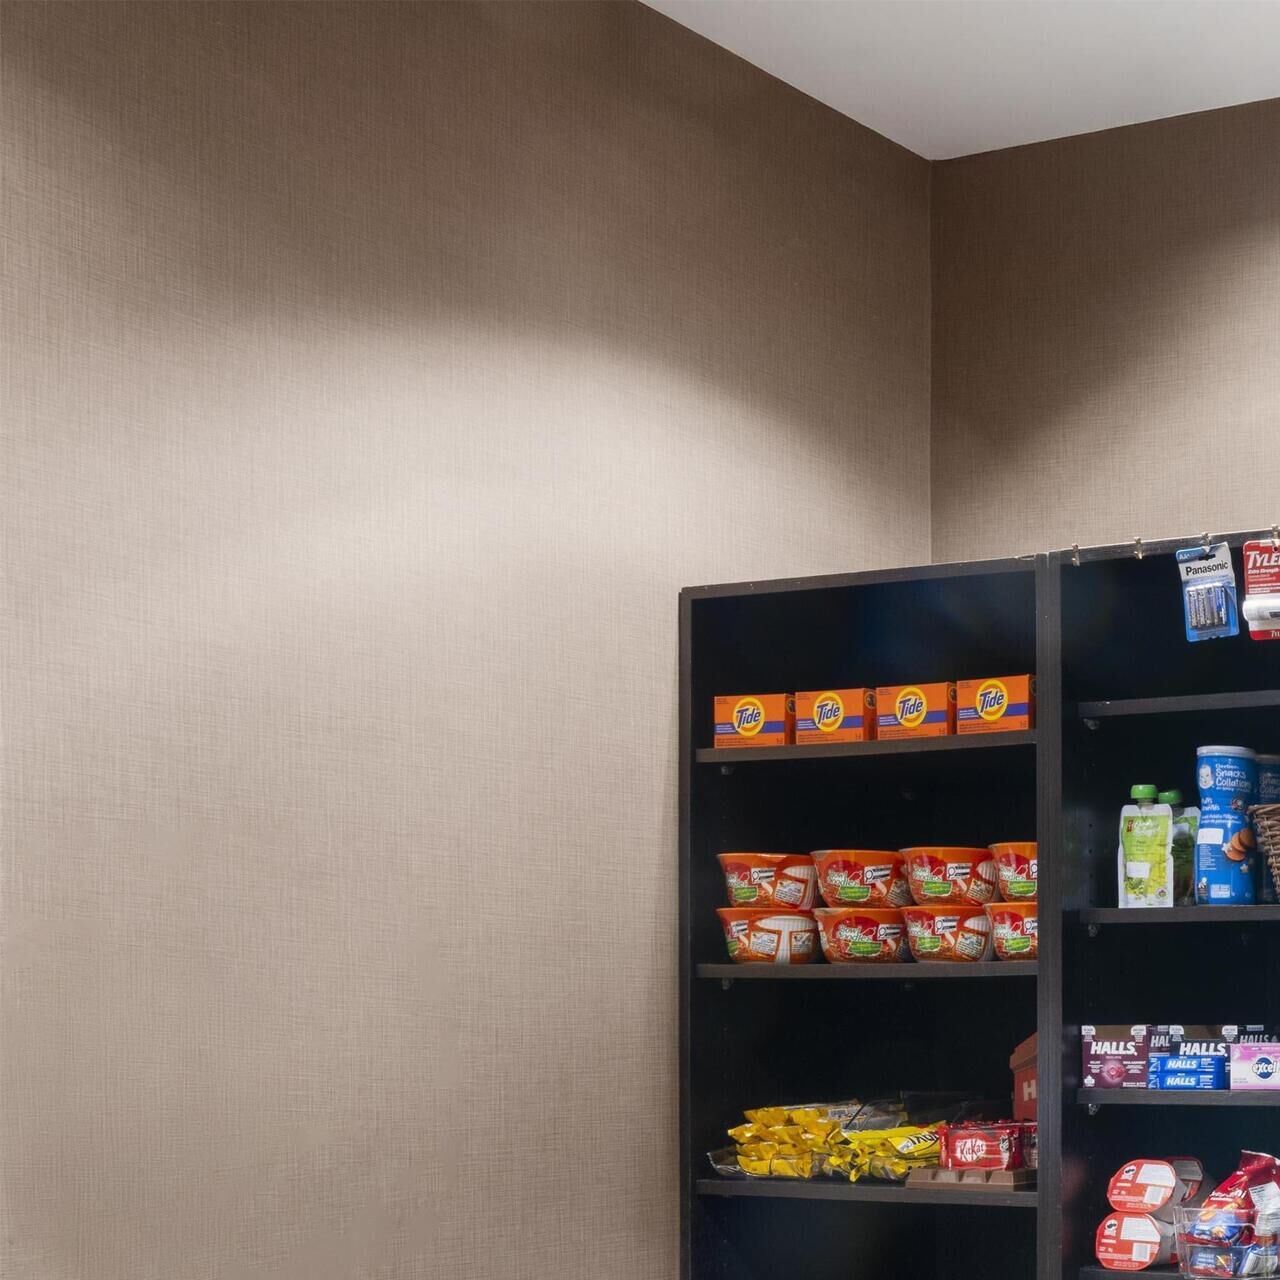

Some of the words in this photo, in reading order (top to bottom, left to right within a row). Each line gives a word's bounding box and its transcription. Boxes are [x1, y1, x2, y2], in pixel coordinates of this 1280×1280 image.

[1185, 560, 1229, 576] Panasonic
[898, 695, 925, 719] Tide
[978, 689, 1005, 713] Tide
[735, 705, 762, 730] Tide
[816, 700, 841, 724] Tide
[1215, 768, 1247, 778] Snacks
[1090, 1041, 1135, 1056] HALLS
[1178, 1042, 1226, 1057] HALLS
[1167, 1059, 1198, 1070] HALLS
[1252, 1061, 1280, 1074] excel
[1165, 1076, 1197, 1087] HALLS
